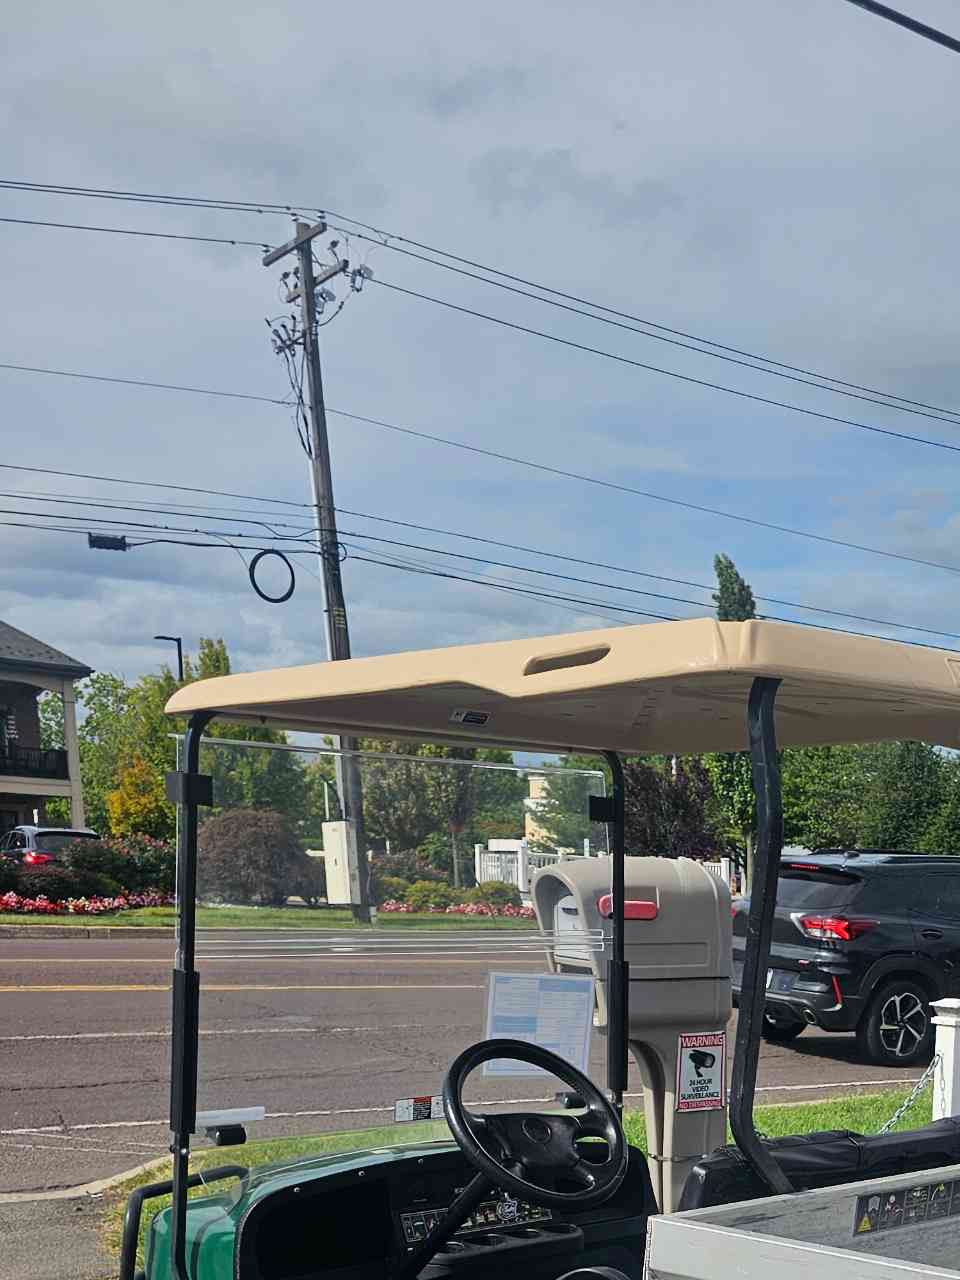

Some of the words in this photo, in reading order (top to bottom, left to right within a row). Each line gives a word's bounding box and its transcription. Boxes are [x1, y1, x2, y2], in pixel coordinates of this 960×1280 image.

[682, 1035, 723, 1047] WARNING
[696, 1078, 713, 1087] HOUR
[691, 1085, 710, 1093] VIDEO
